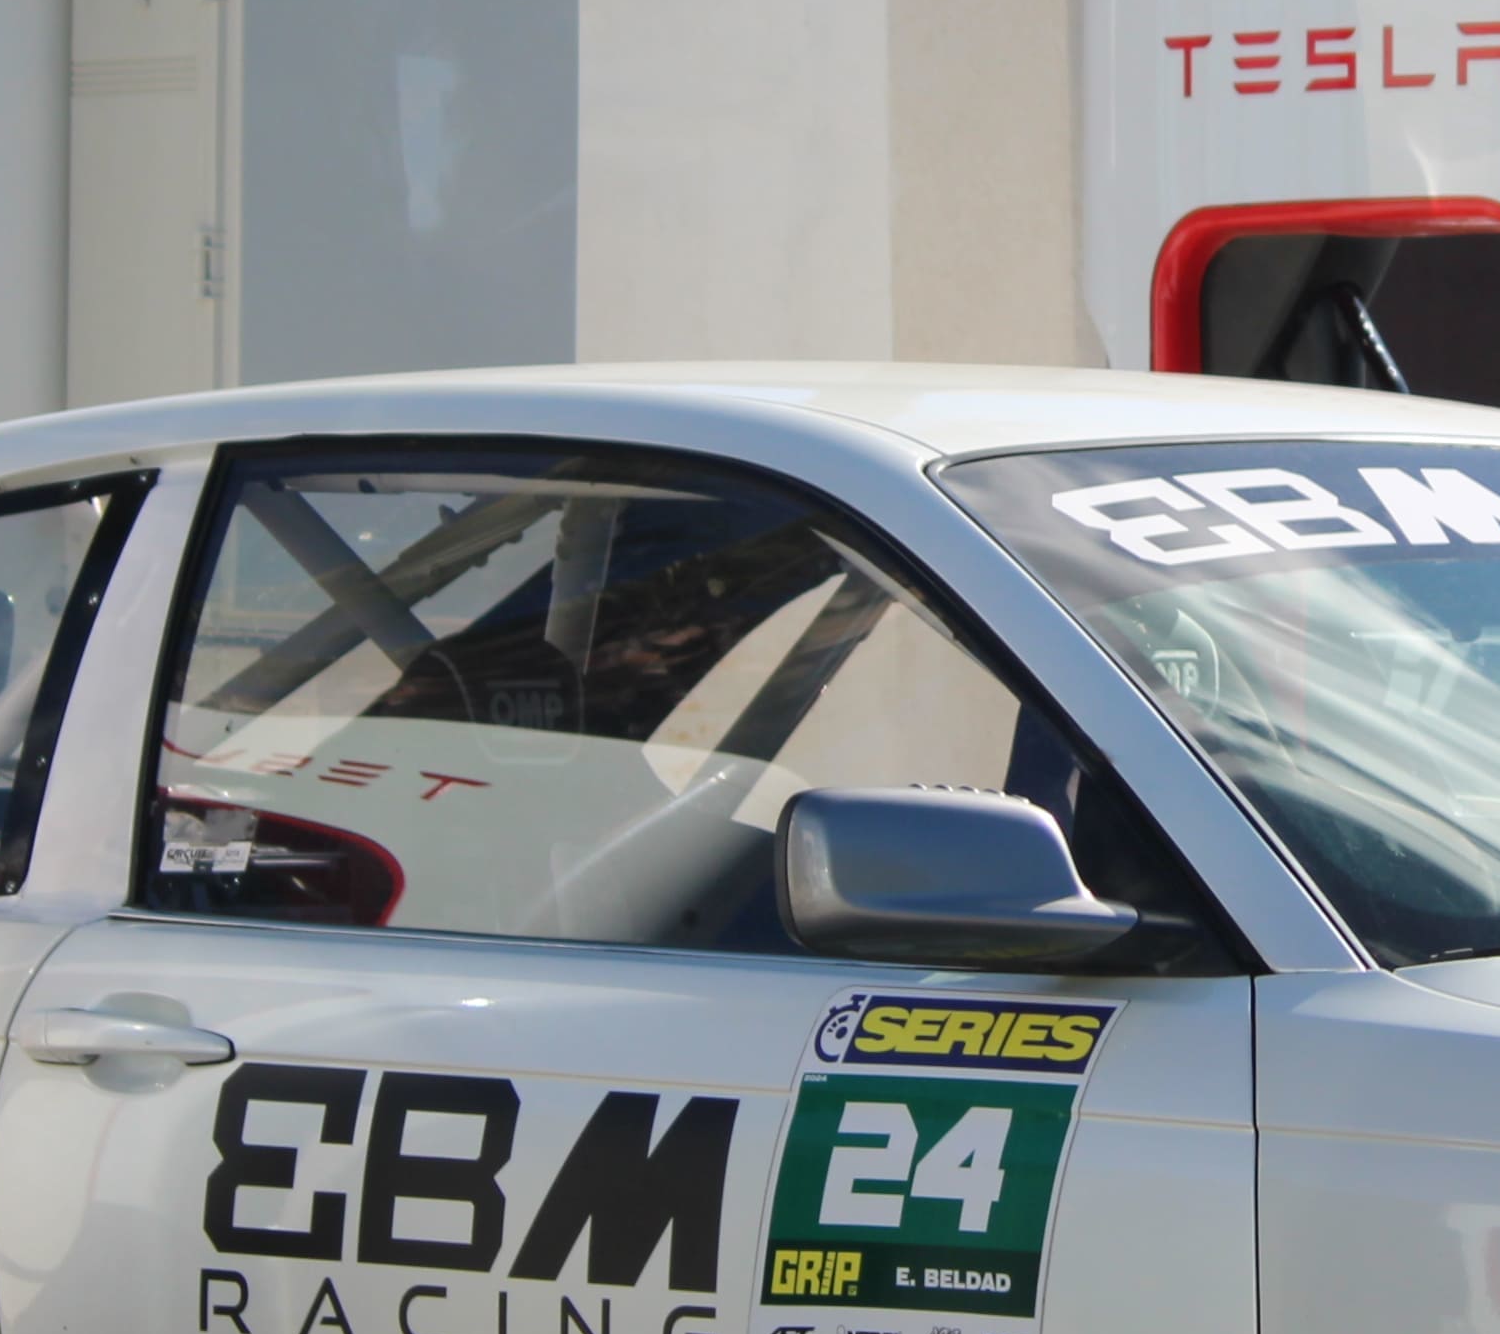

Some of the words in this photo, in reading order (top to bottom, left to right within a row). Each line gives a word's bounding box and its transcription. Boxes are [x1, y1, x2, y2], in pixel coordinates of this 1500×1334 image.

[854, 1005, 1102, 1062] SERIES
[203, 1061, 741, 1294] EBM
[818, 1100, 1014, 1234] 24
[895, 1266, 917, 1287] E.
[923, 1267, 1012, 1293] BELDAD
